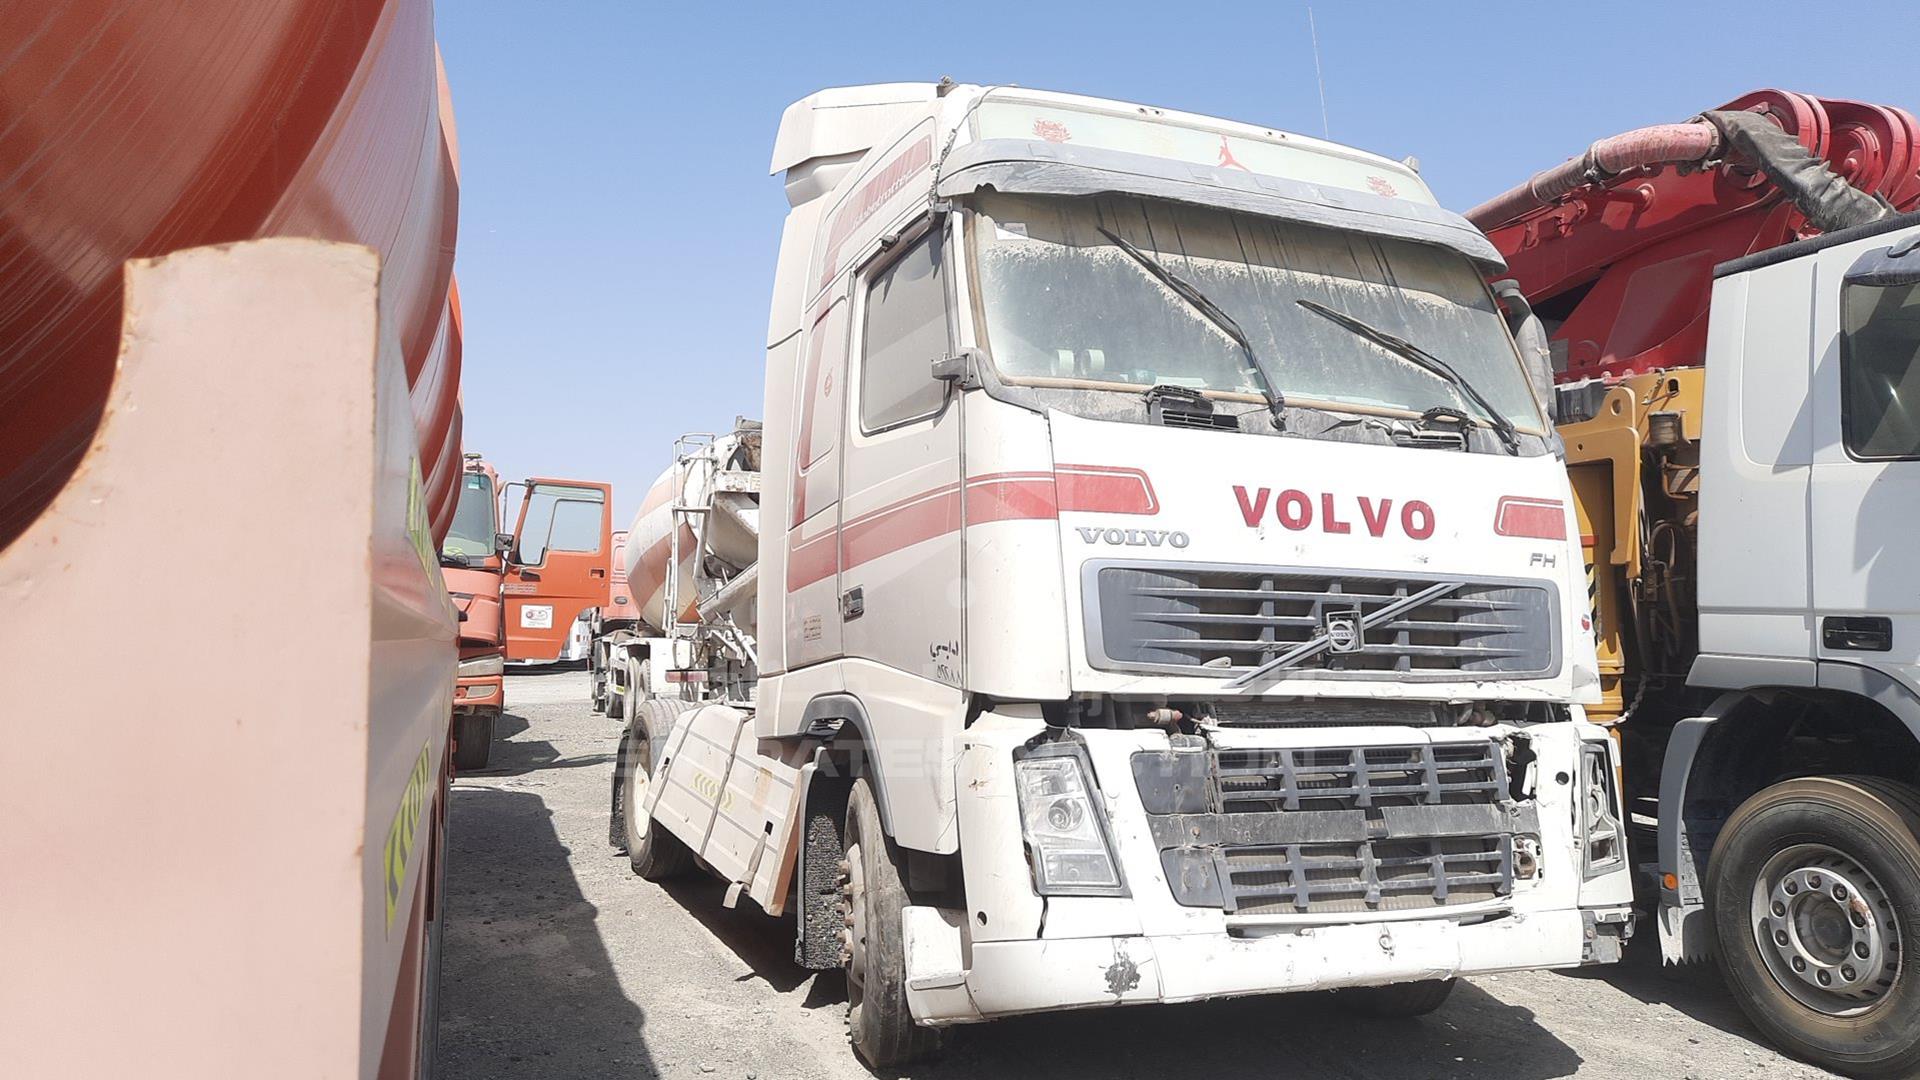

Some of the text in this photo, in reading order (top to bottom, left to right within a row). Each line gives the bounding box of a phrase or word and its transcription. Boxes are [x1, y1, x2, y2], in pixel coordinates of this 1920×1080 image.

[1232, 485, 1436, 541] VOLVO
[1076, 526, 1190, 548] VOLVO
[1529, 552, 1556, 568] FH
